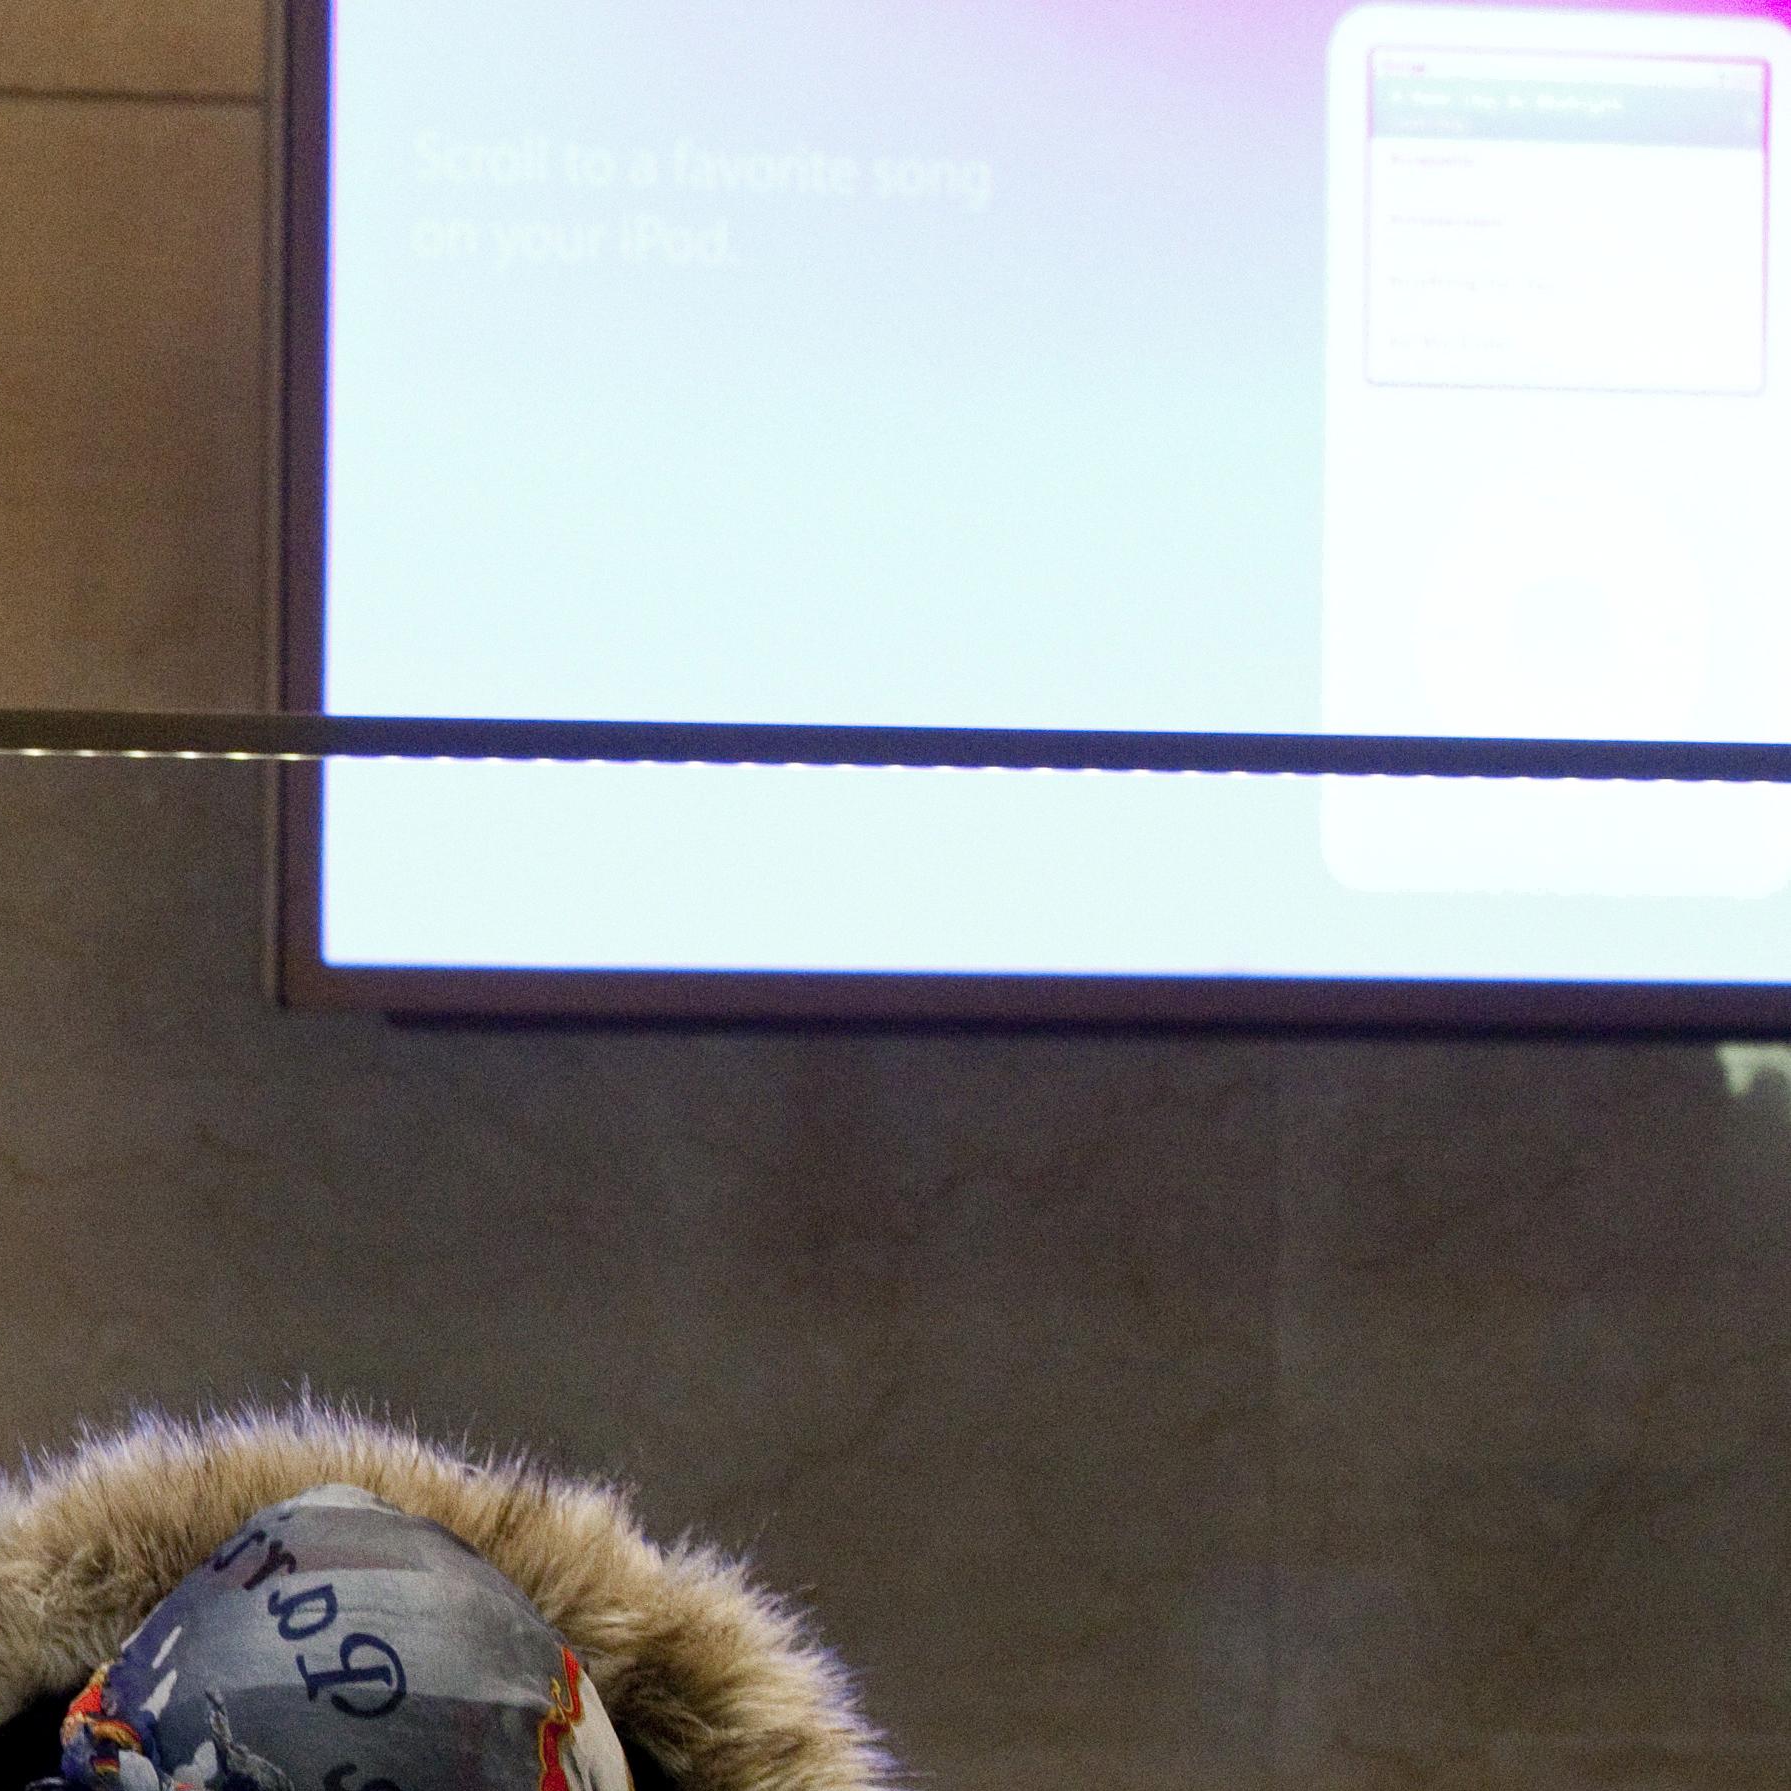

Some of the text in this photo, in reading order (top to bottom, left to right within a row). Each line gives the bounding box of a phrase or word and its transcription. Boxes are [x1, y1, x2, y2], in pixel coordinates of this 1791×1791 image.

[413, 128, 994, 213] Scroll to a favorite song
[410, 218, 479, 261] on
[491, 221, 606, 272] your
